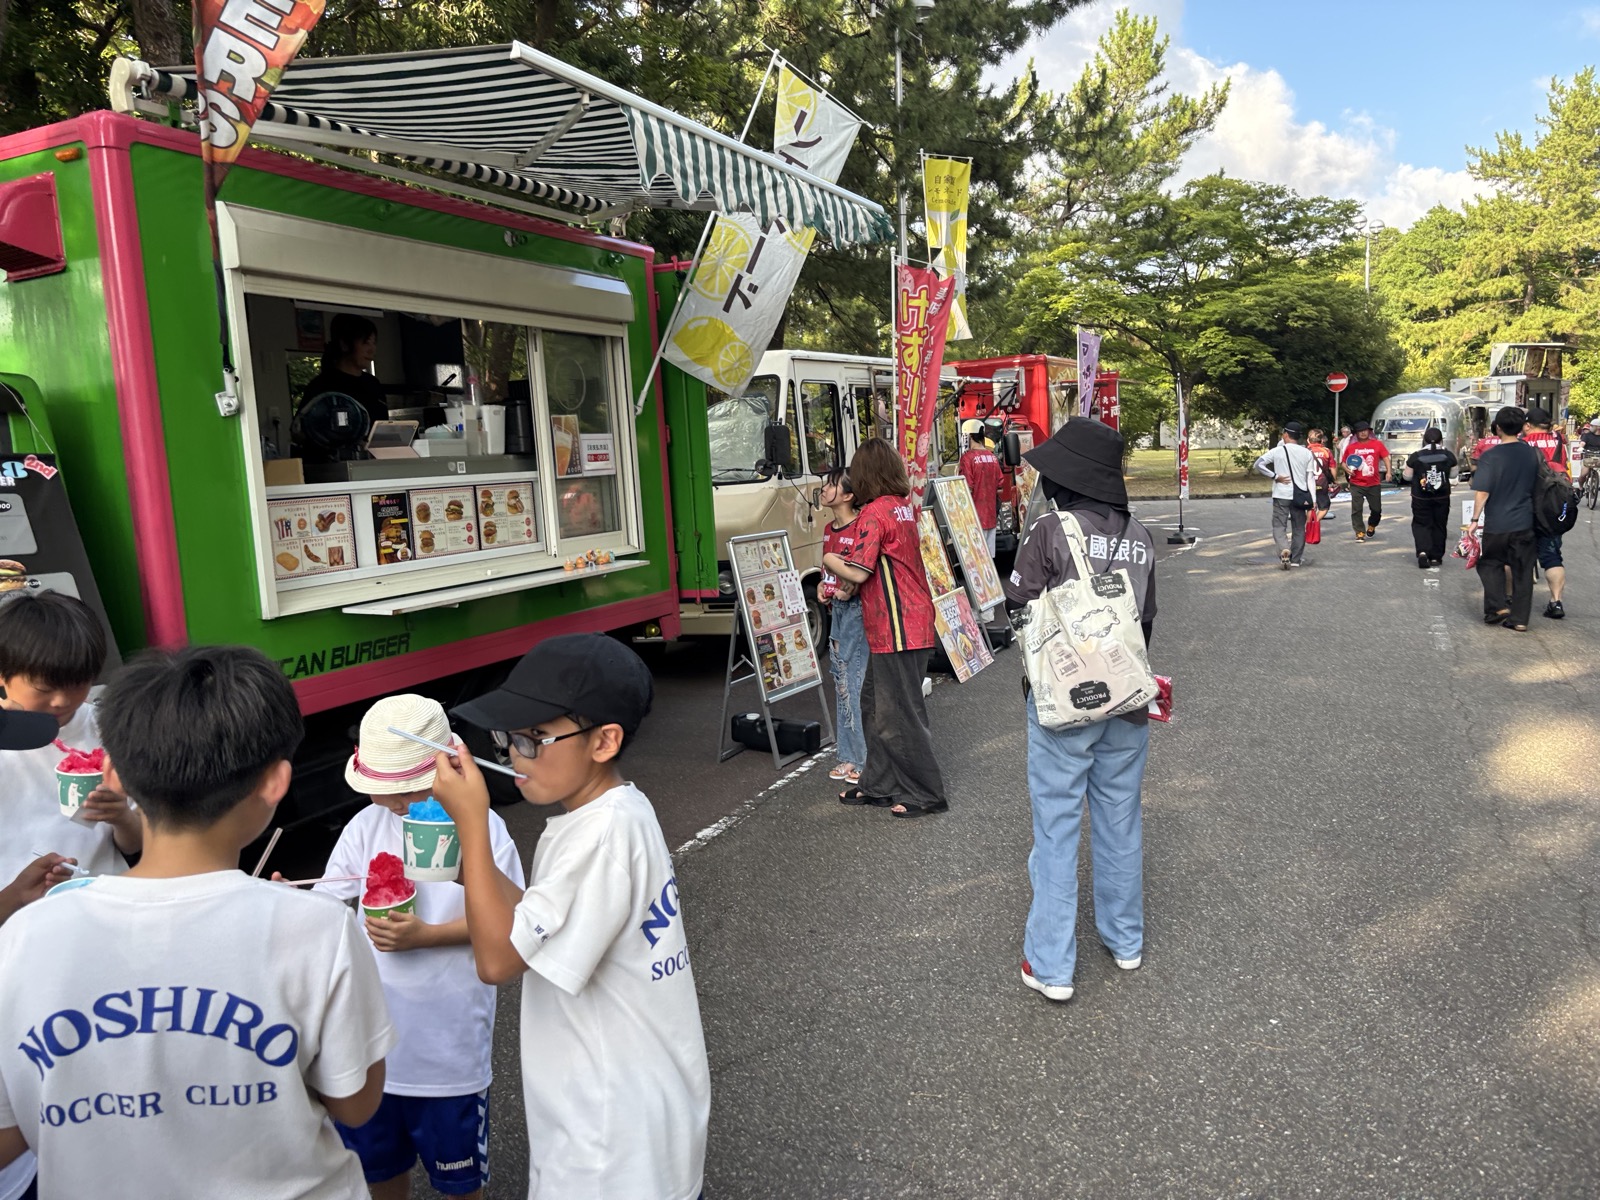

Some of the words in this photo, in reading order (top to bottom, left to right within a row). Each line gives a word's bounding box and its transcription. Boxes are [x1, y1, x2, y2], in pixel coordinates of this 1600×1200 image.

[1084, 533, 1148, 565] 國銀行
[330, 632, 411, 670] BURGER
[1076, 692, 1107, 704] PRODUCT
[18, 986, 299, 1081] NOSHIRO
[185, 1081, 278, 1106] CLUB
[435, 1156, 474, 1171] hummel
